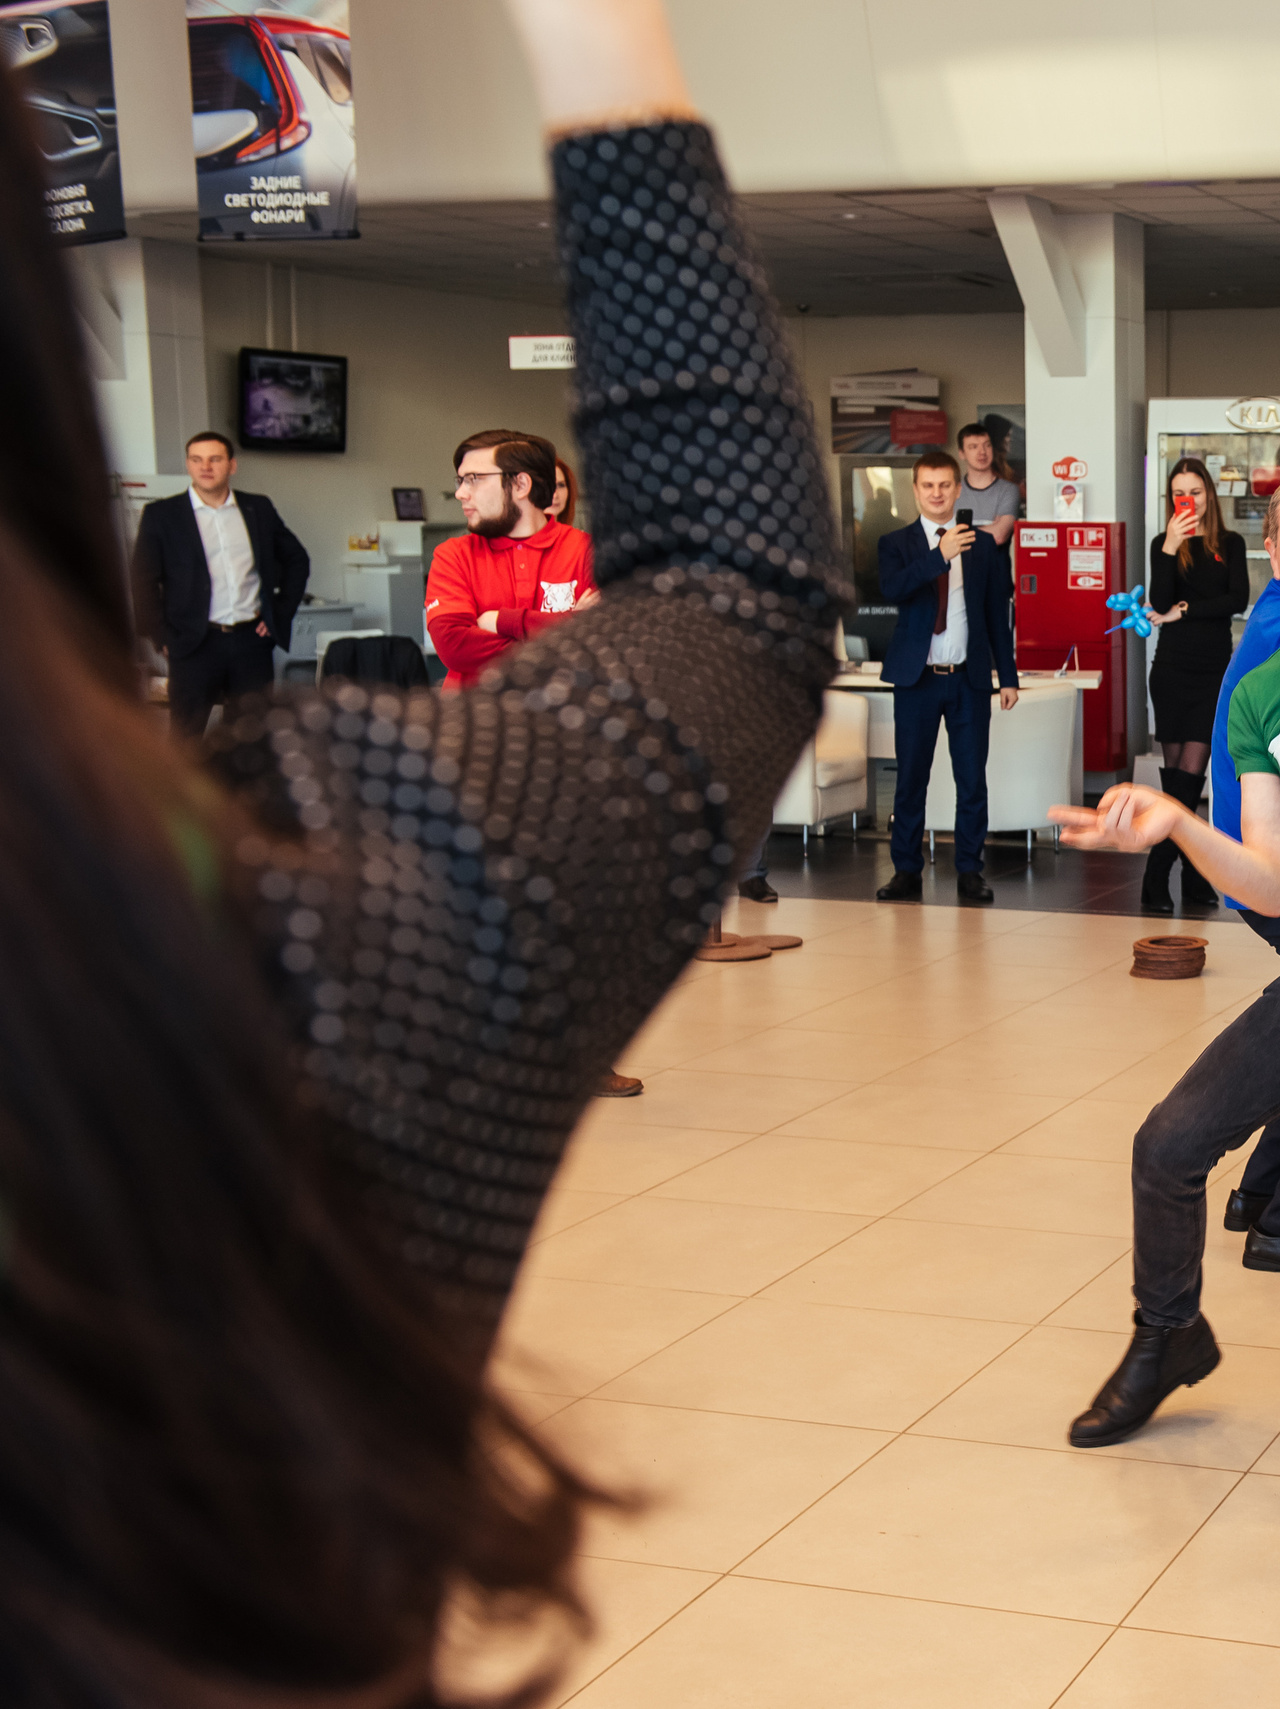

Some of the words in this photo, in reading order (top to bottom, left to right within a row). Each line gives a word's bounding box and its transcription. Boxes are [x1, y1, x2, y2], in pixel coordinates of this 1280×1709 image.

[250, 175, 302, 191] ЗАДНИЕ
[224, 191, 330, 209] СВЕТОДИОДНЫЕ
[250, 209, 306, 224] ФОНАРИ
[1239, 405, 1280, 425] KIA
[1022, 533, 1035, 542] ПК
[1045, 533, 1055, 542] 13
